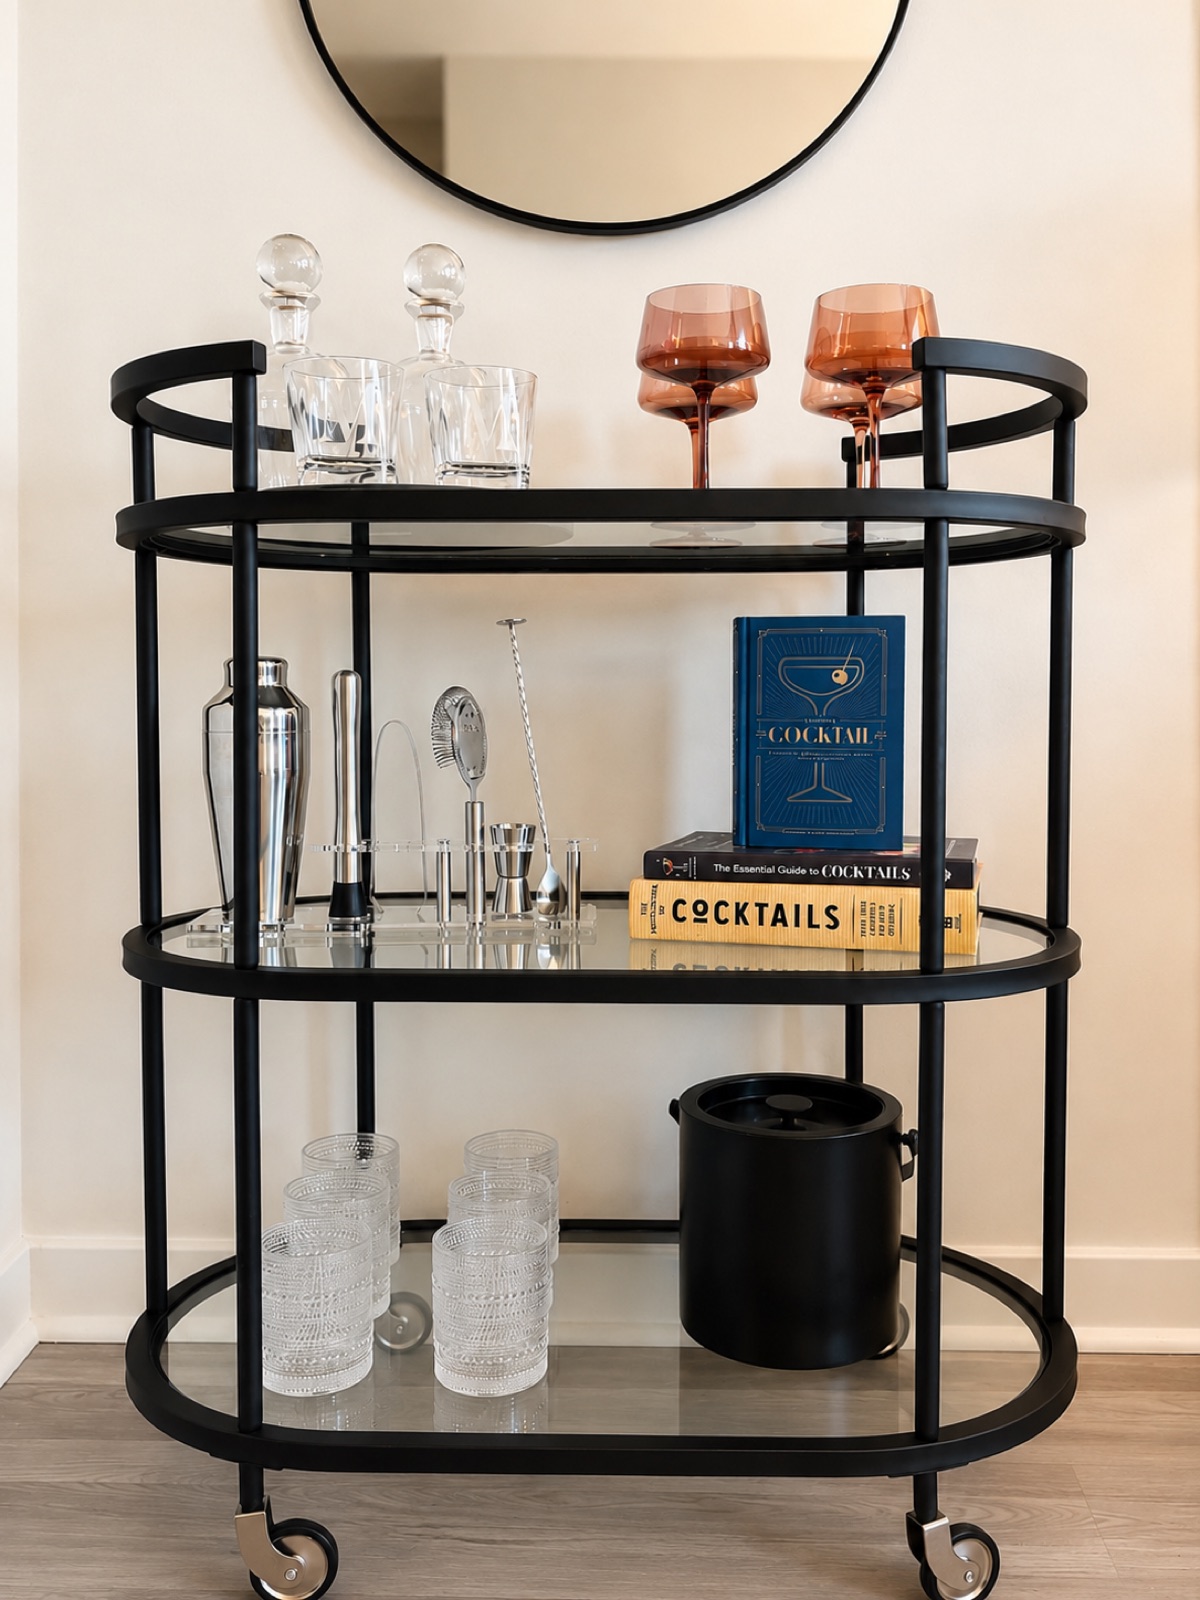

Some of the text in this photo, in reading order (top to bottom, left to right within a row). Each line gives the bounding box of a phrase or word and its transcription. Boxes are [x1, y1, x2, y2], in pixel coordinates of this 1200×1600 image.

[768, 726, 873, 744] COCKTAIL
[713, 863, 911, 881] The Essential Guide to COCKTAILS
[671, 898, 840, 930] COCKTAILS
